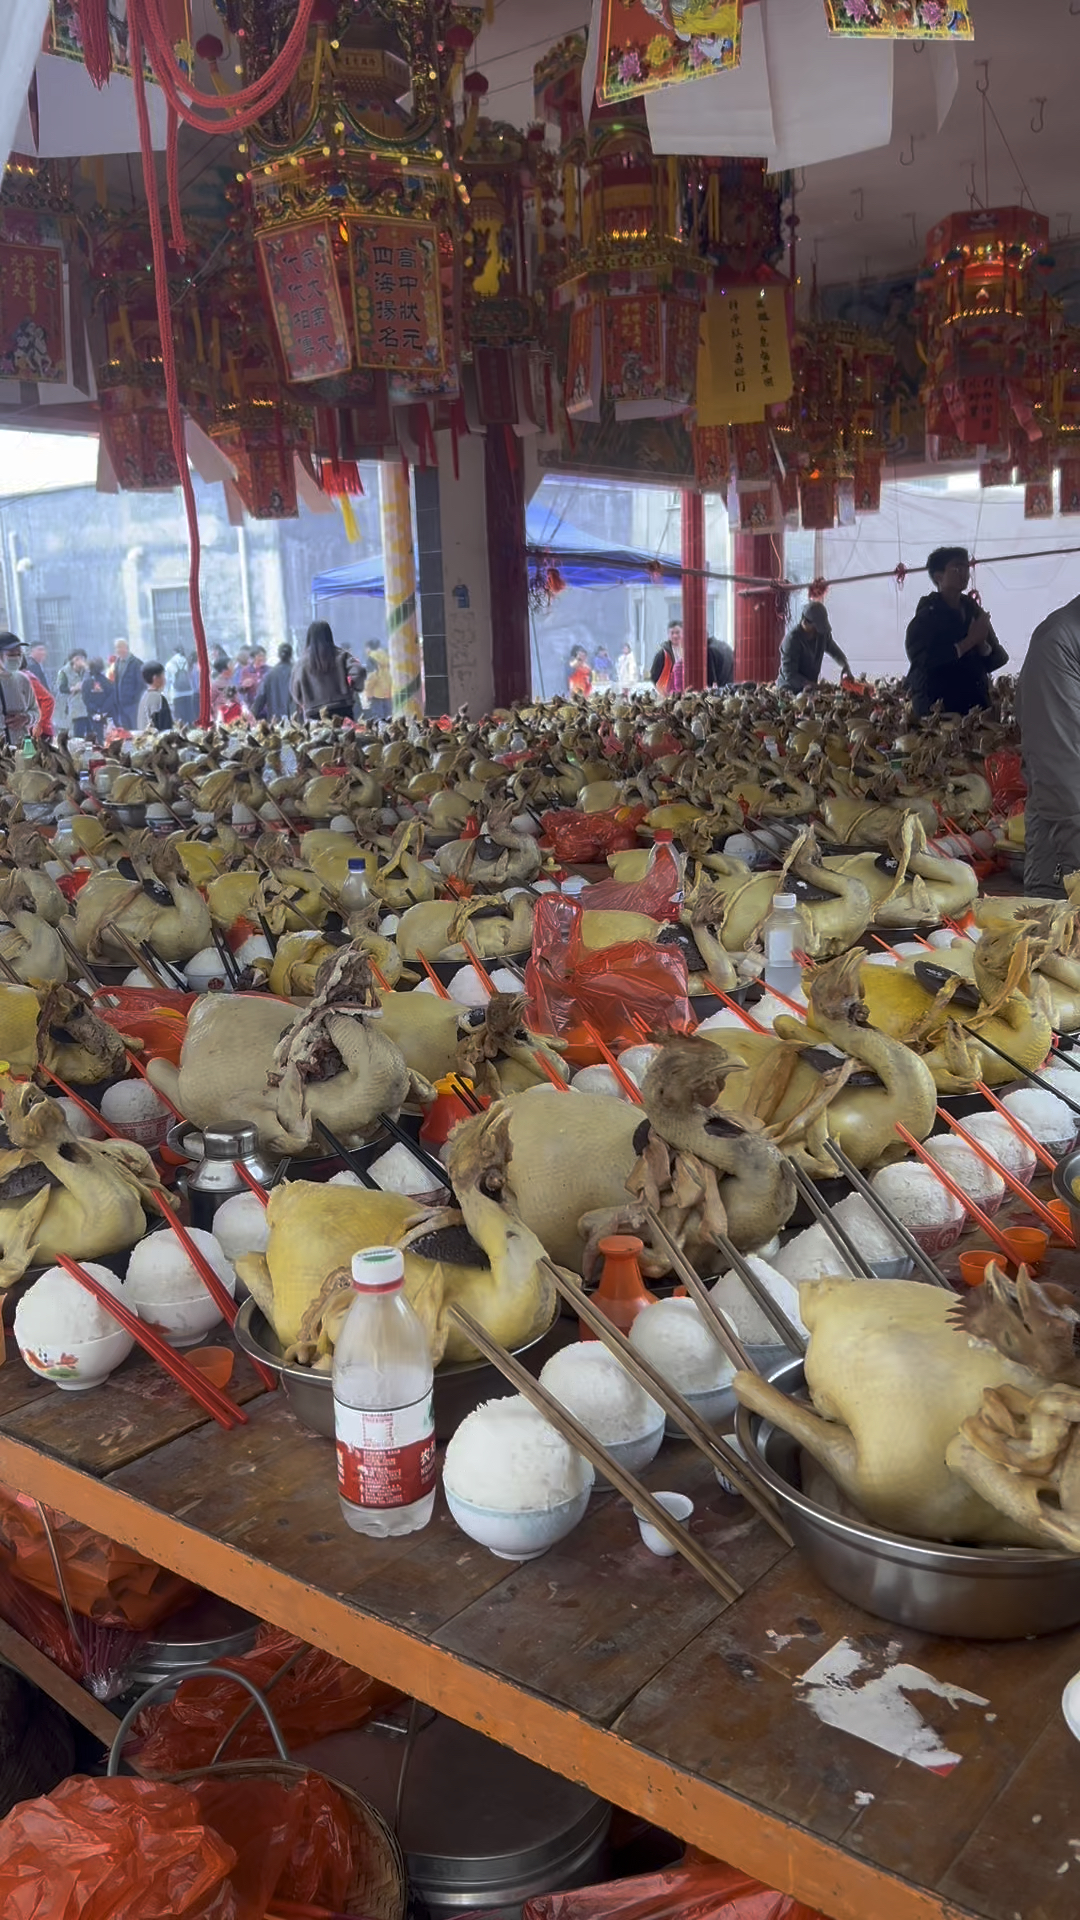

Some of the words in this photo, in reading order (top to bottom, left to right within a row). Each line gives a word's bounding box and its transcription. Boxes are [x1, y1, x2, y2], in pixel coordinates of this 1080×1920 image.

[372, 246, 399, 348] 四海揚名
[396, 246, 424, 351] 高中狀元
